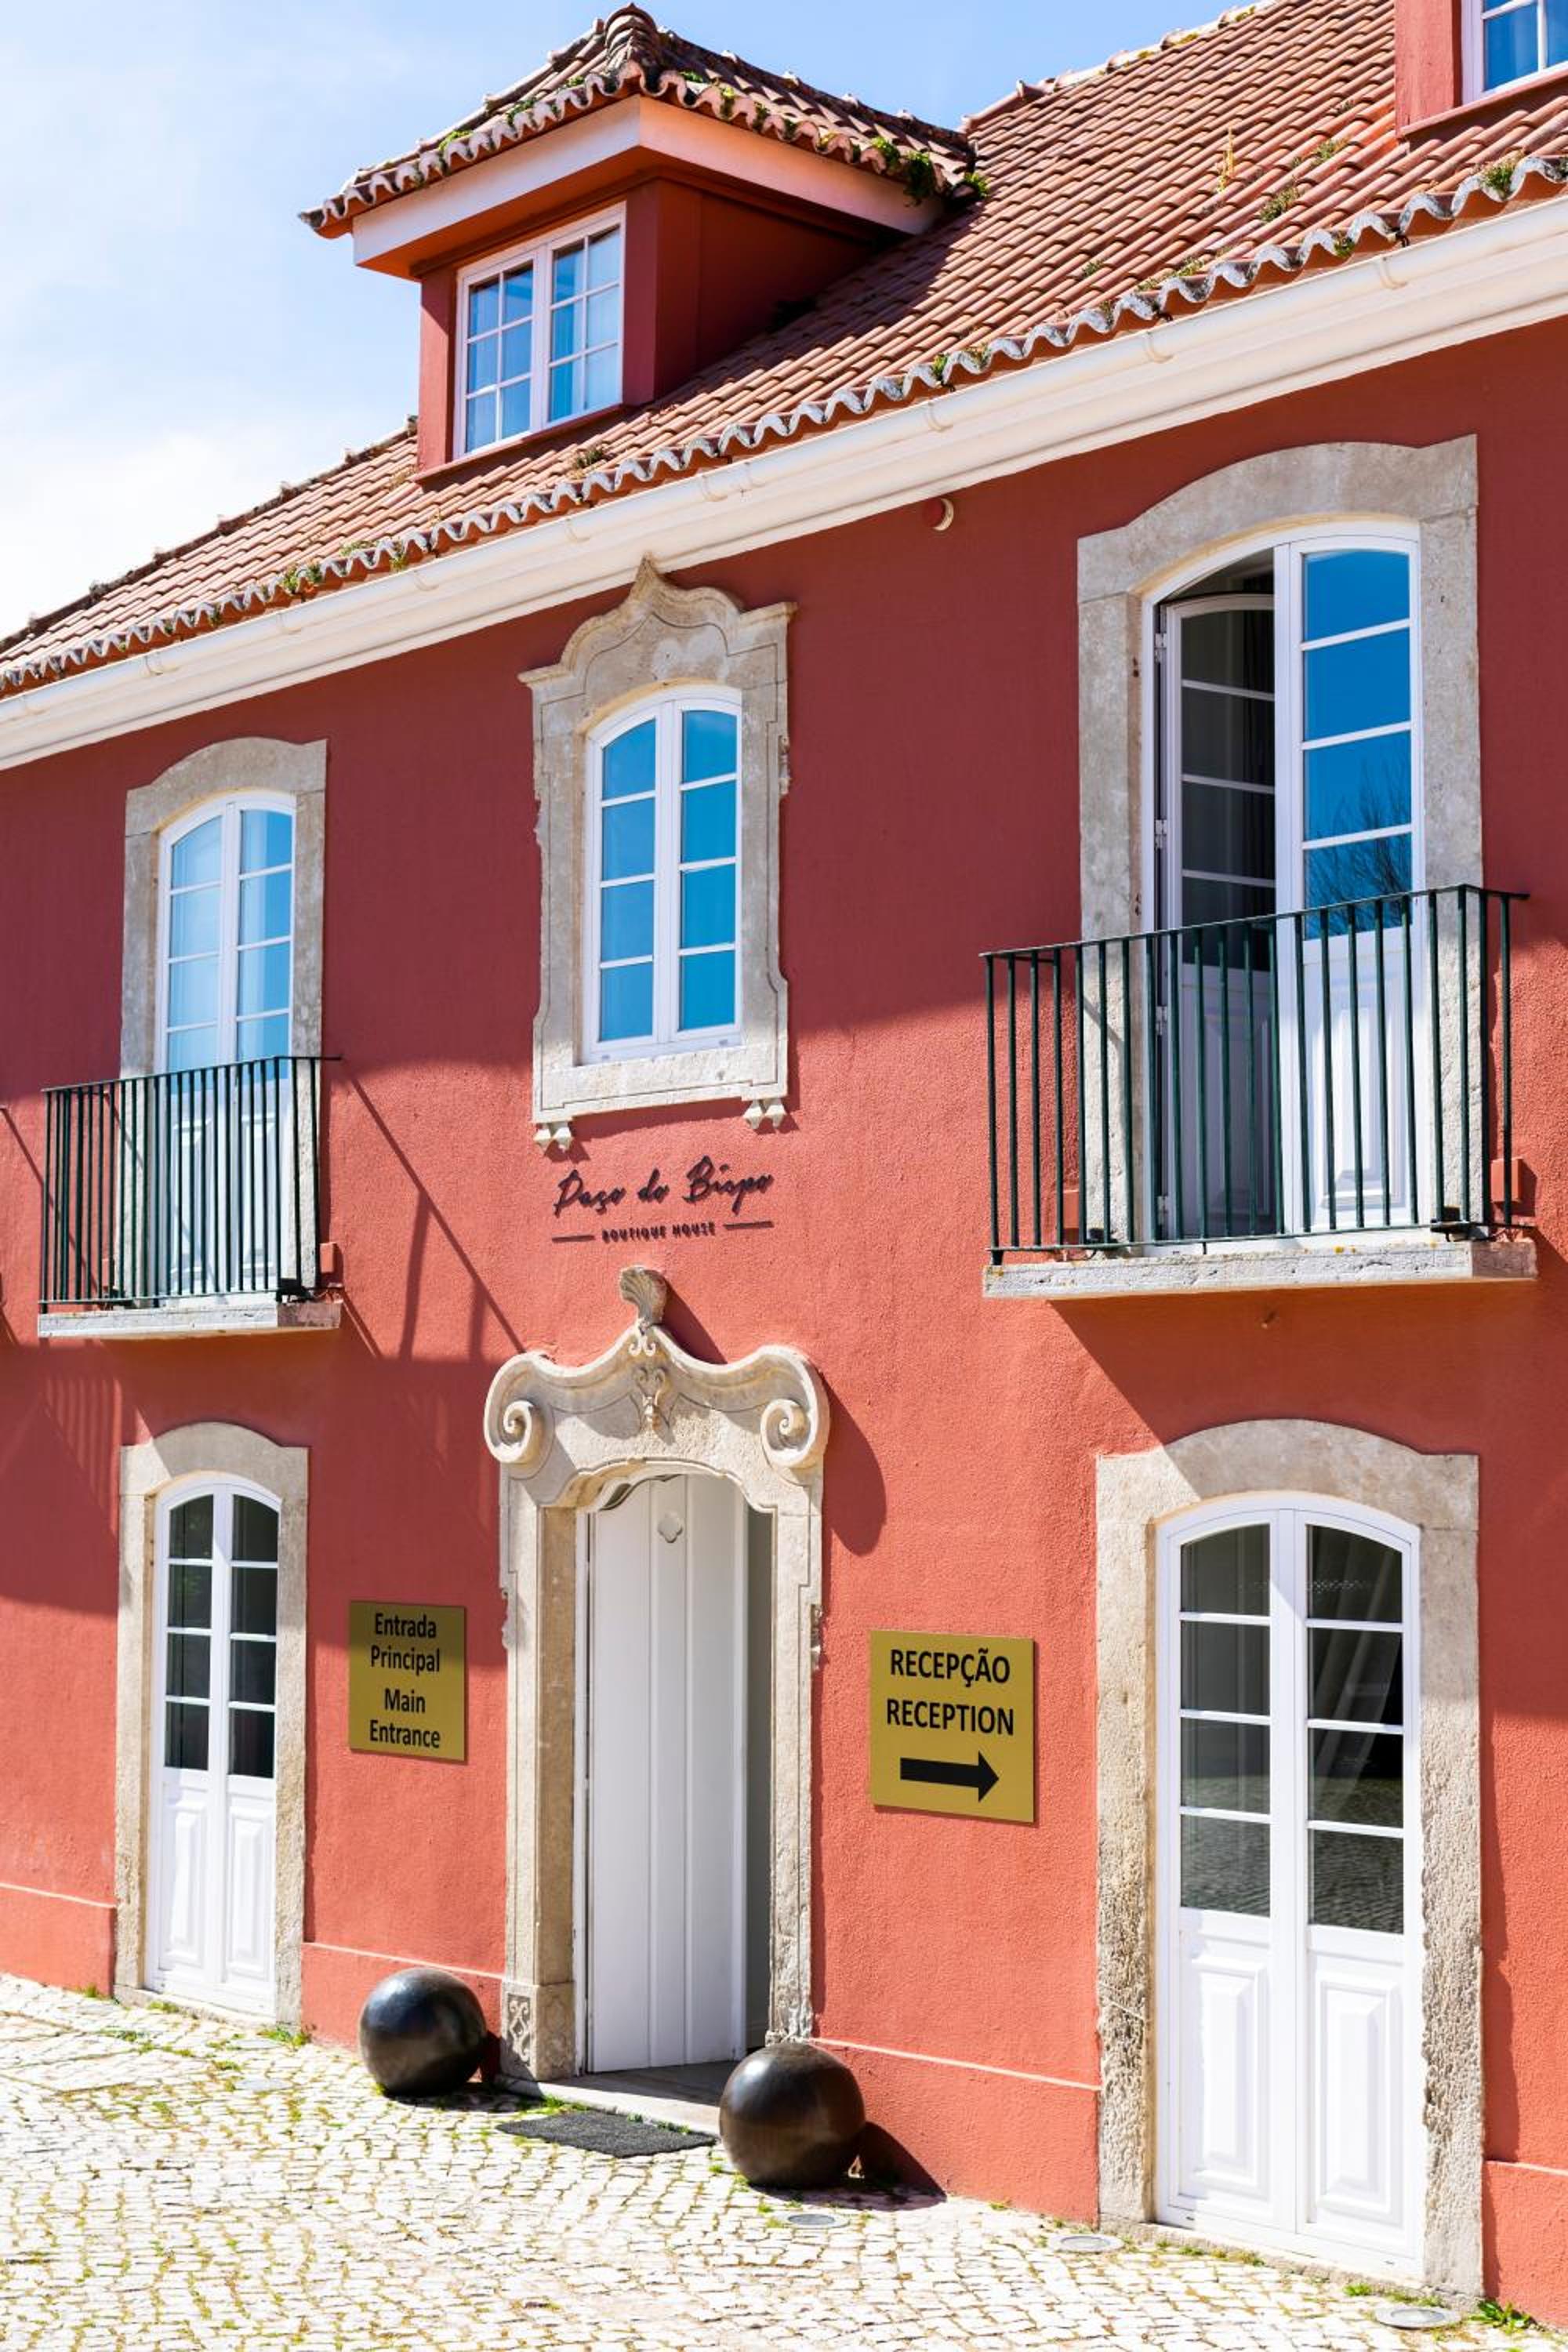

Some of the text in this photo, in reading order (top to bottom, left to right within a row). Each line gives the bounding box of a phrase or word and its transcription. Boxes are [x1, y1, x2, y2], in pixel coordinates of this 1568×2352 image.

[637, 1168, 670, 1203] do
[682, 1155, 775, 1215] Bispo
[601, 1221, 716, 1243] BOUTIQUE HOUSE
[375, 1612, 437, 1639] Entrada
[371, 1644, 440, 1676] Principal
[890, 1647, 1011, 1687] RECEPÇÃO
[384, 1688, 426, 1713] Main
[887, 1698, 1014, 1736] RECEPTION
[369, 1719, 441, 1748] Entrance
